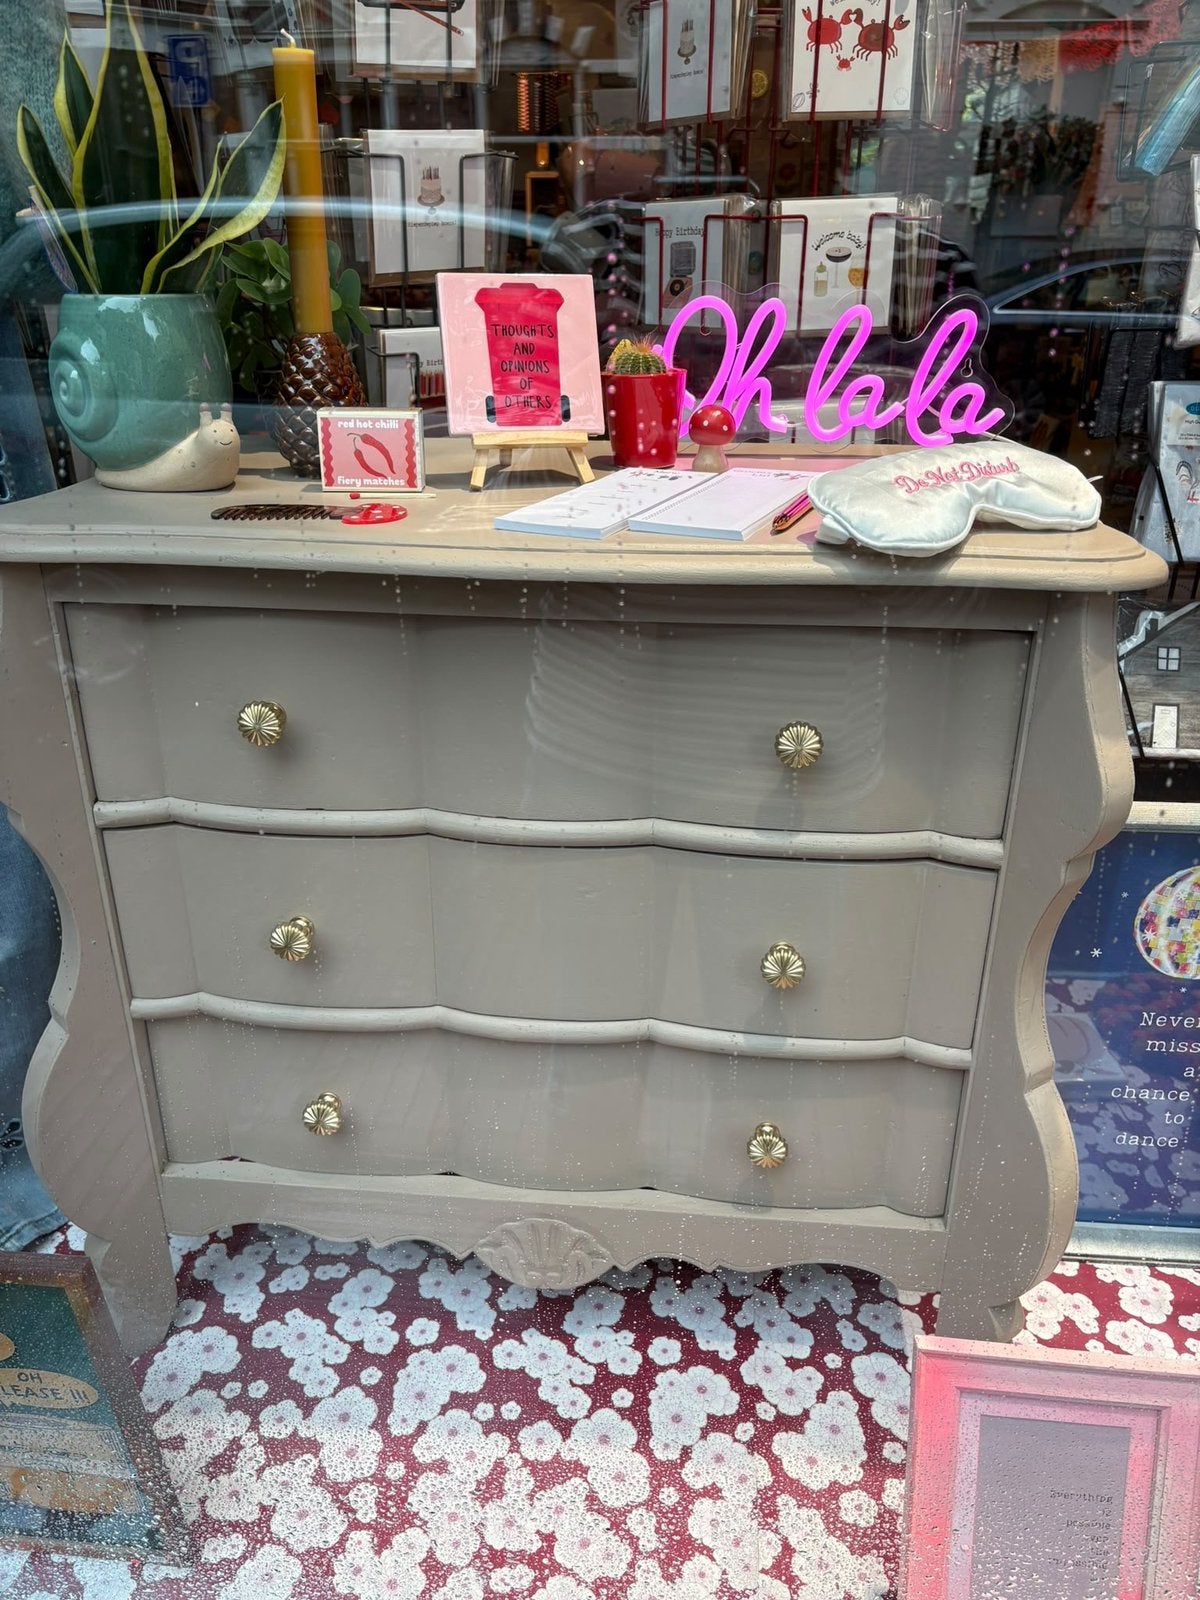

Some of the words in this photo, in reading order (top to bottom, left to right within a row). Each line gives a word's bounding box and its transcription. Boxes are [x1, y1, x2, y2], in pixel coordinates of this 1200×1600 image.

[490, 323, 555, 338] THOUGHTS
[513, 342, 535, 355] AND
[500, 360, 550, 373] OPINIONS
[652, 295, 788, 438] Oh
[804, 304, 905, 442] la
[905, 308, 1006, 448] la
[520, 377, 534, 390] OF
[505, 395, 552, 409] OTHERS
[337, 419, 355, 429] red
[356, 420, 374, 429] hot
[374, 420, 399, 429] chilli
[337, 475, 362, 487] fiery
[363, 477, 405, 486] matches
[894, 475, 930, 494] Do
[924, 466, 961, 485] Not
[960, 456, 1020, 481] Disturb
[1145, 1039, 1200, 1053] miss
[1183, 1066, 1195, 1078] a
[1111, 1085, 1190, 1101] chance
[1165, 1111, 1185, 1124] to
[1115, 1132, 1179, 1148] dance
[17, 1372, 42, 1384] OH
